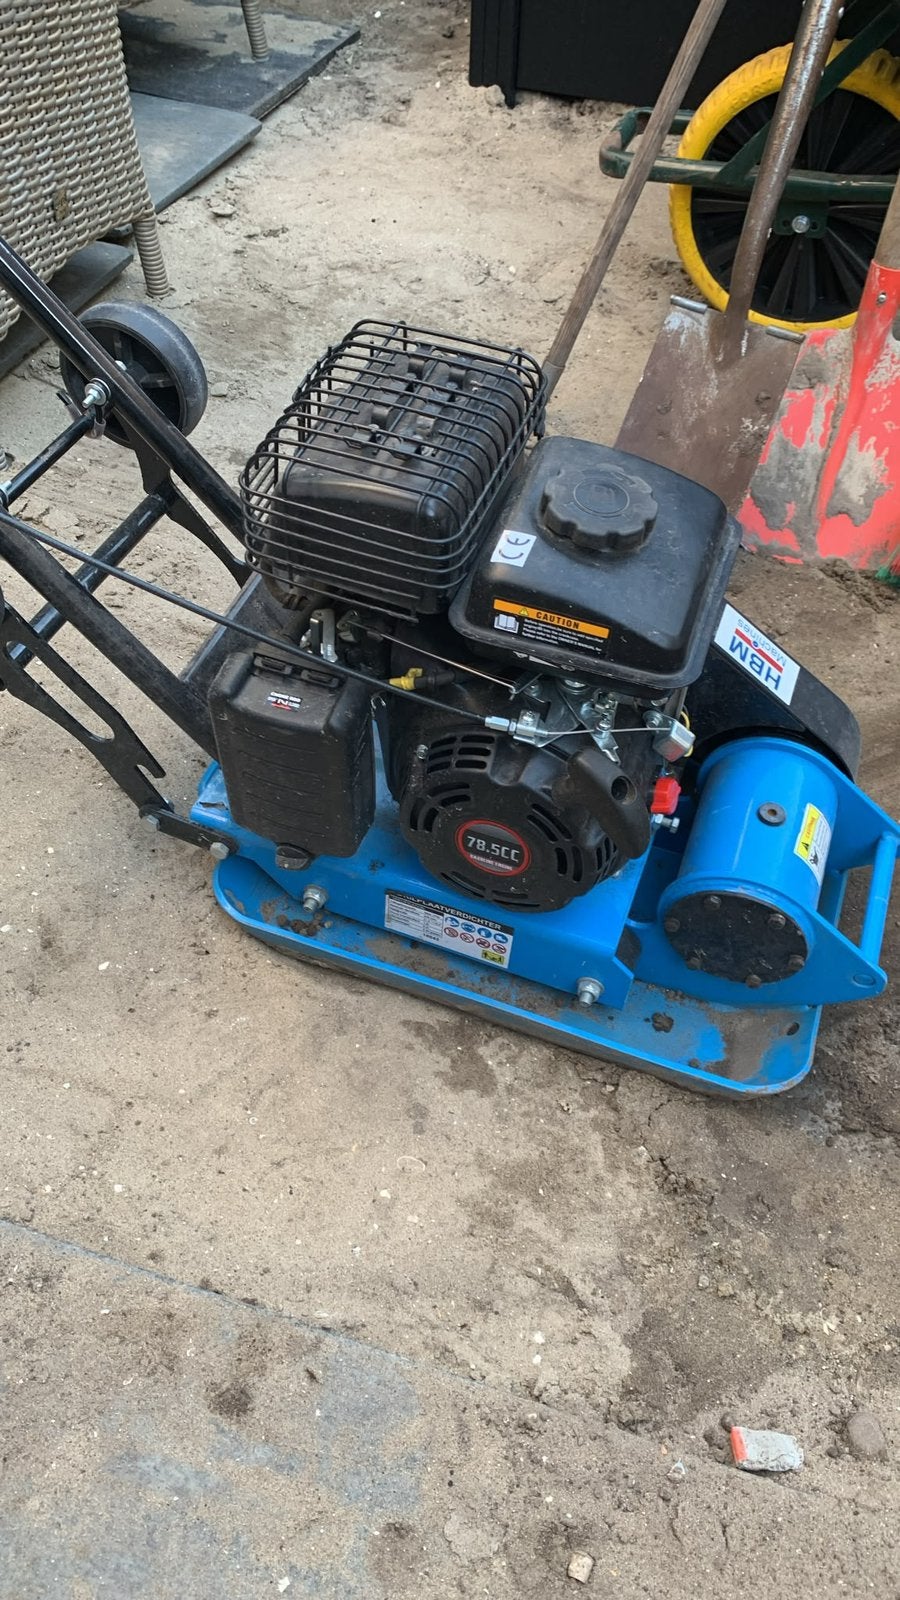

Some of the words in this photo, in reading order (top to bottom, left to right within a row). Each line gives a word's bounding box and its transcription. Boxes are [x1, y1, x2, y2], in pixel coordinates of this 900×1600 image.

[535, 611, 581, 630] CAUTION
[737, 618, 787, 667] Machines
[728, 635, 782, 691] HBM
[466, 835, 520, 864] 78.5CC
